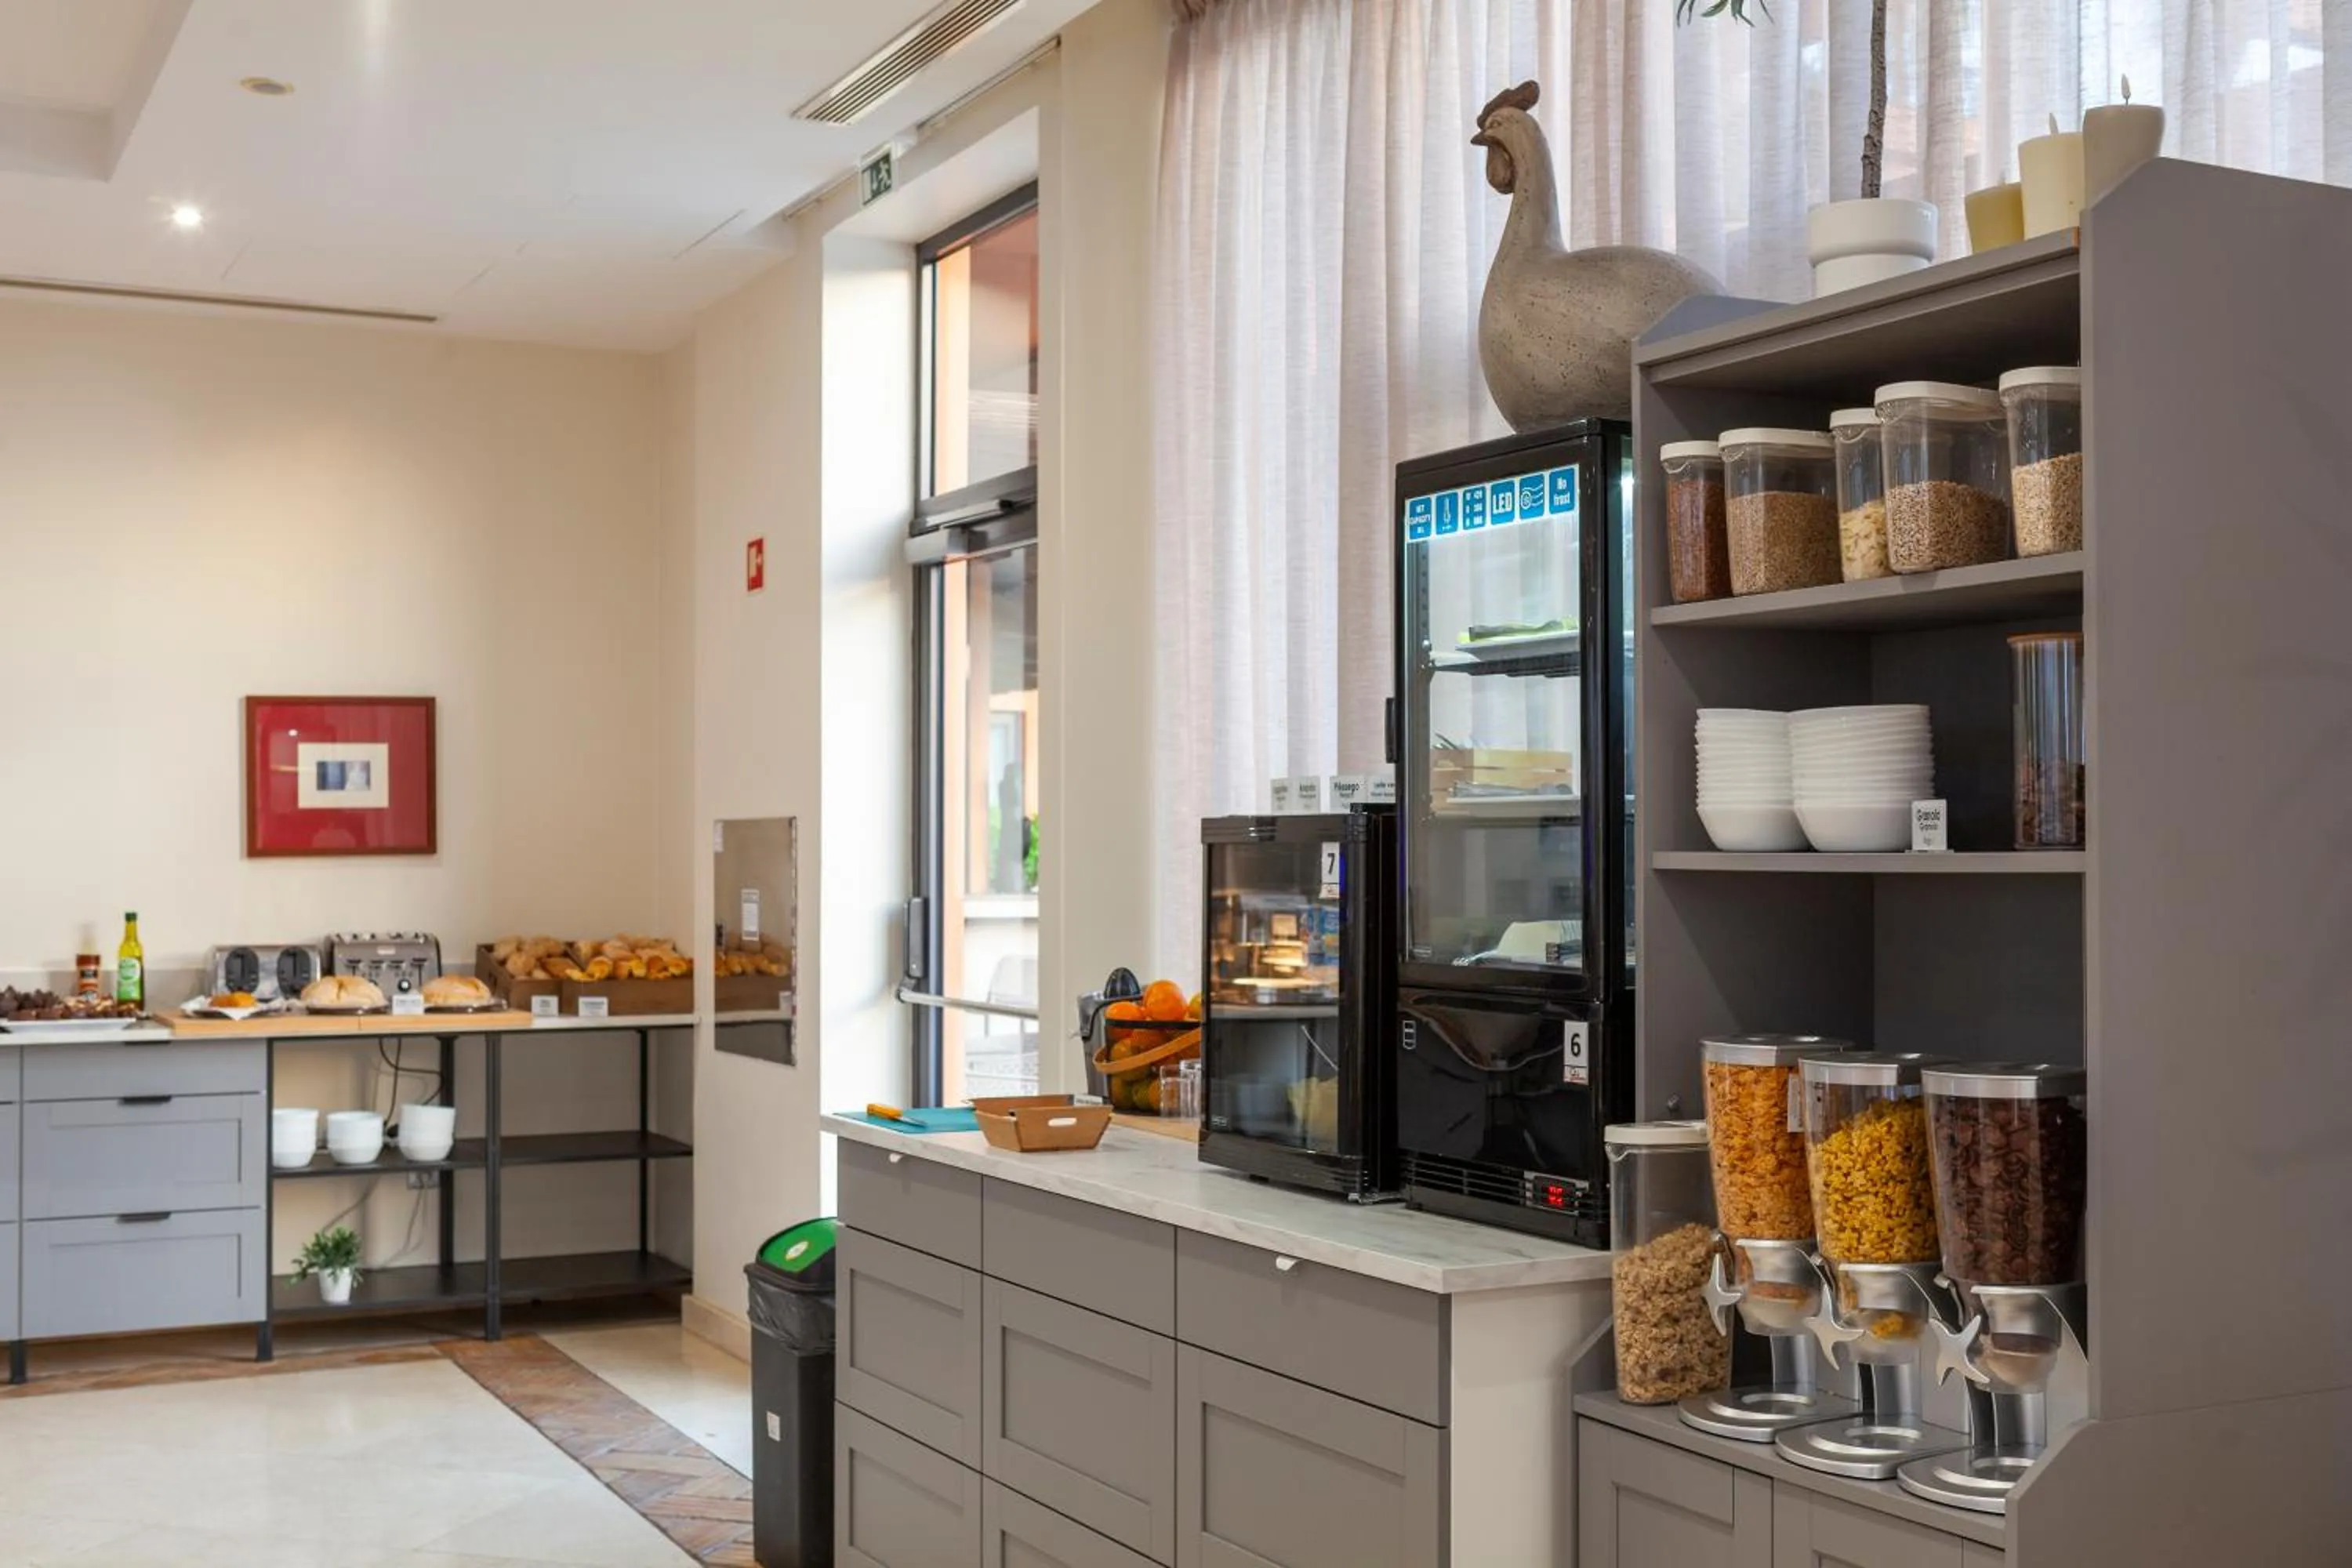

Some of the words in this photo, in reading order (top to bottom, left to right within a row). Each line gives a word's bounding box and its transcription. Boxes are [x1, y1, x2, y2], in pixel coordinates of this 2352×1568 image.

[1492, 492, 1513, 515] LED
[1327, 852, 1335, 876] 7
[1570, 1032, 1581, 1058] 6
